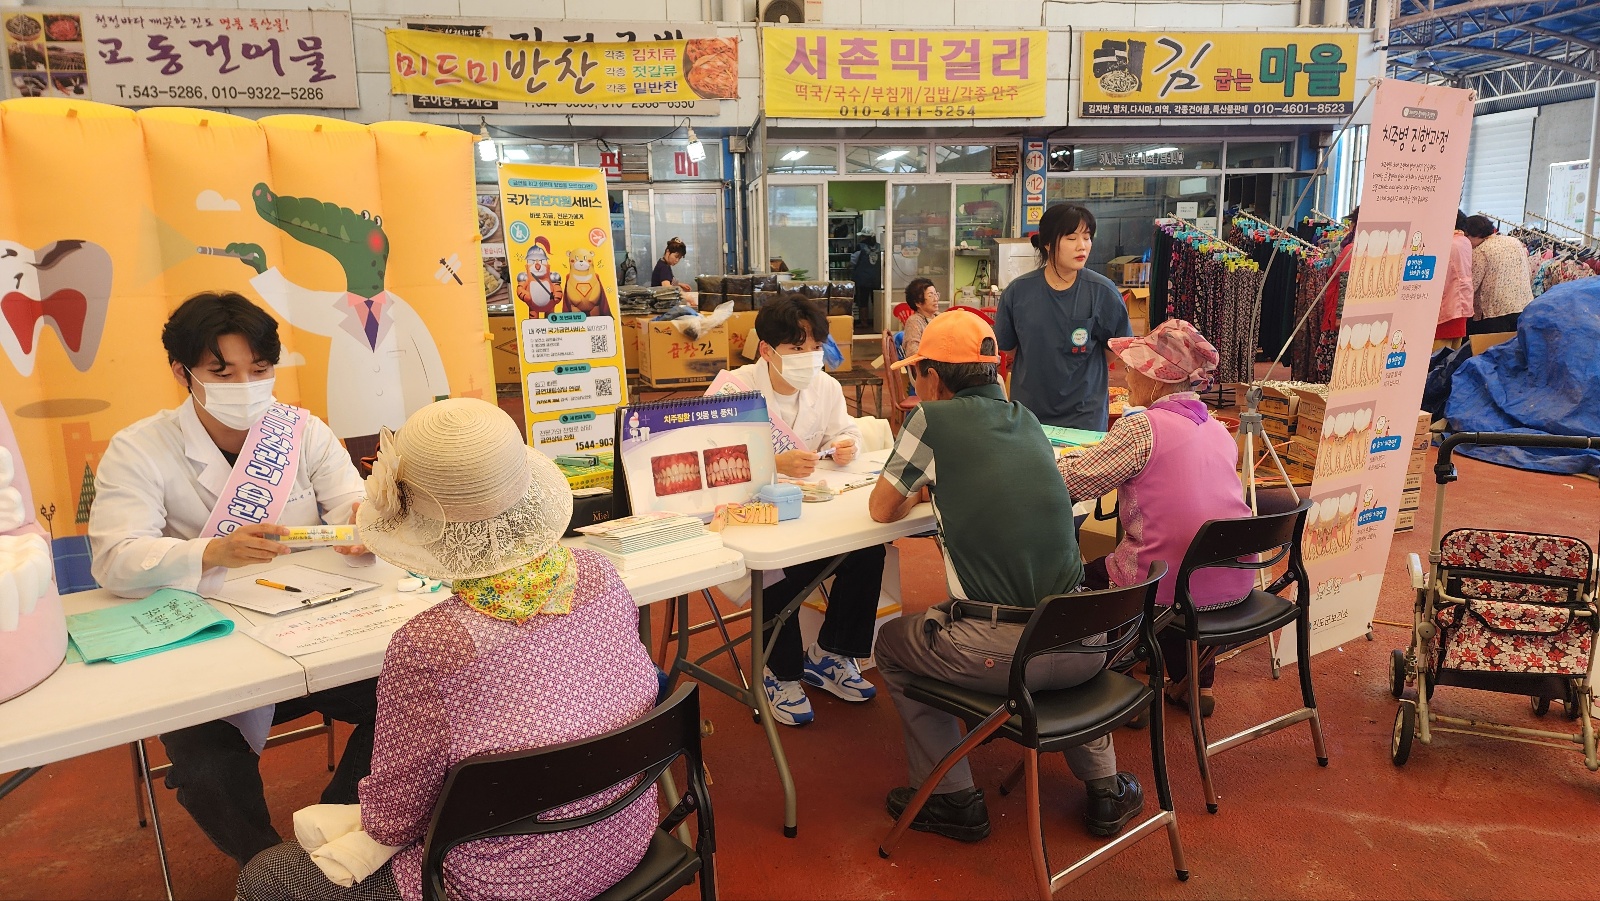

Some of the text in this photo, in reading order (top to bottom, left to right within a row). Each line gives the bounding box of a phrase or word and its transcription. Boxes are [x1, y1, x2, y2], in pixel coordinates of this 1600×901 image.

[95, 14, 290, 31] 청정바다 깨끗한 진도 명품 특산물!
[605, 48, 678, 62] 각종 김치류
[785, 36, 1030, 81] 서촌막걸리
[395, 47, 599, 95] 미드미 반찬
[605, 64, 678, 78] 각종 젓갈류
[1152, 36, 1347, 98] 김 굽는 마을
[211, 86, 324, 101] 010-9322-5286
[606, 83, 627, 94] 각종
[992, 85, 1019, 100] 안주
[839, 105, 976, 117] 010-4111-5254
[1253, 103, 1345, 114] 010-4601-8523
[1382, 124, 1450, 153] 치주병 진행과정
[507, 193, 602, 208] 국가금연지원서비스
[668, 341, 714, 359] 곱창김
[663, 413, 691, 424] 치주질환
